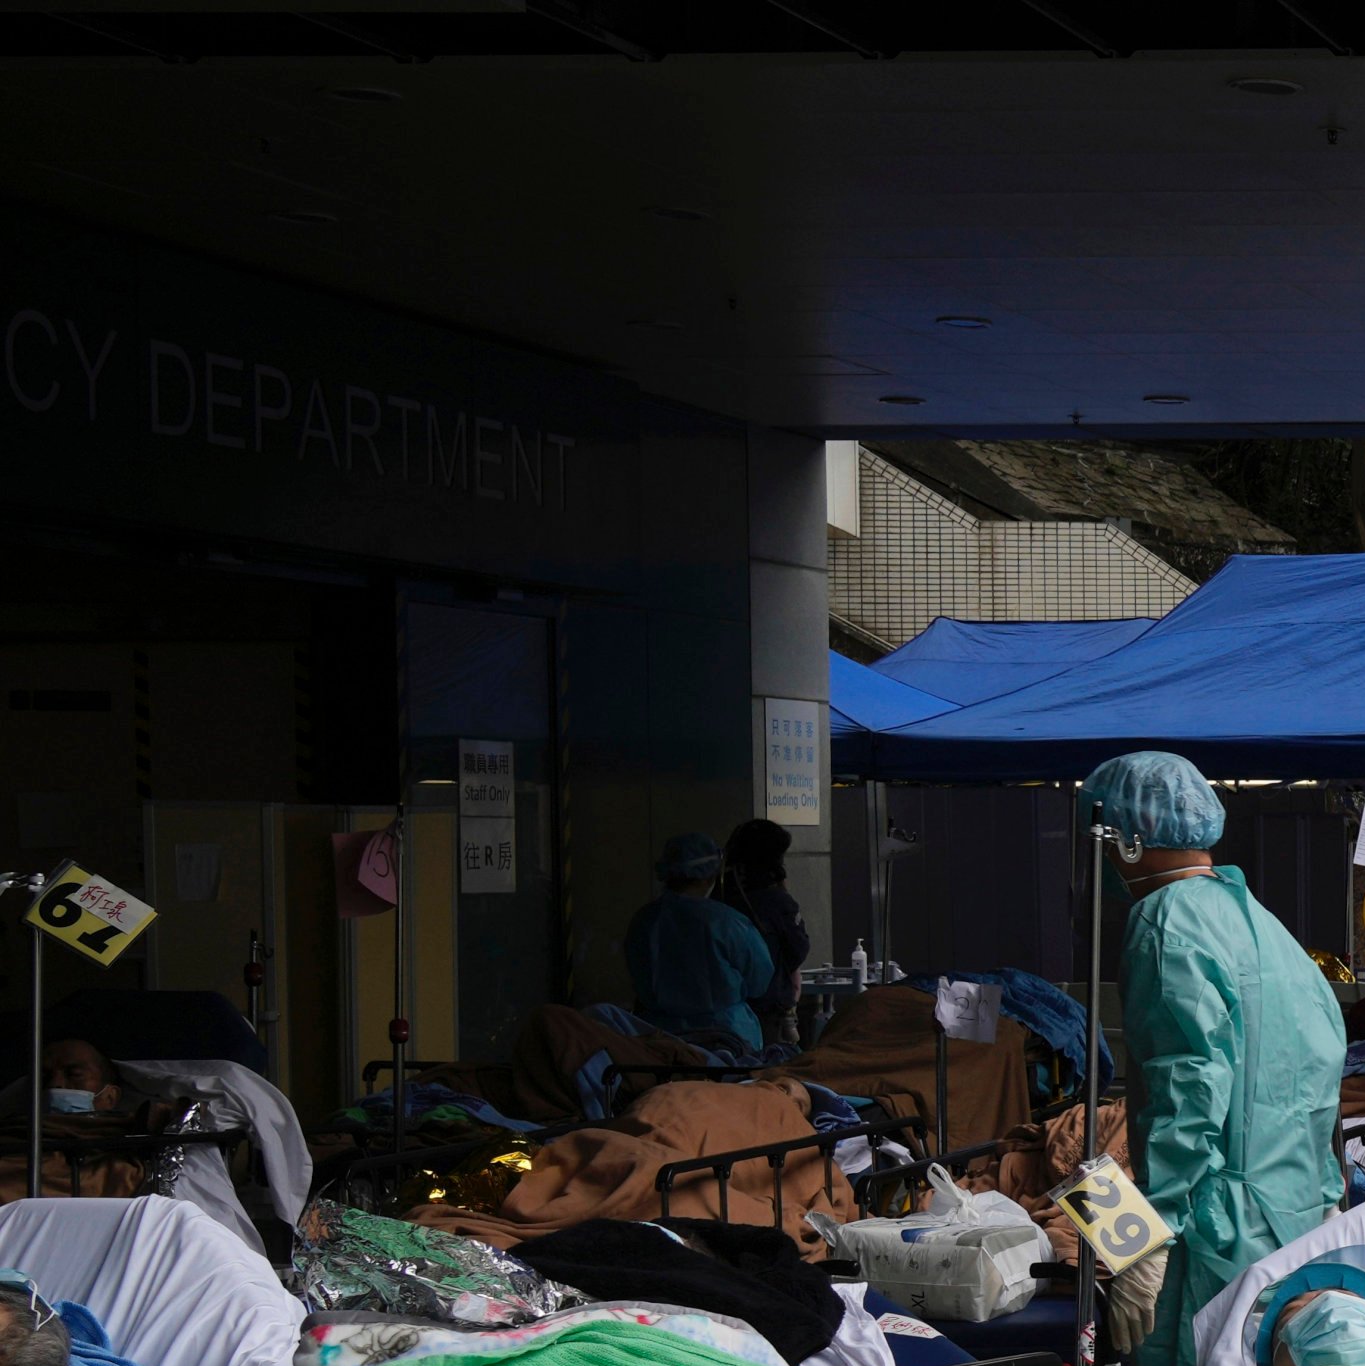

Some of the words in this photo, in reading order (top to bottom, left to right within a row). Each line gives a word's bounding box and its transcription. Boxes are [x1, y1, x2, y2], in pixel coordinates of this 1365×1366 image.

[5, 309, 117, 422] CY
[149, 338, 576, 513] DEPARTMENT
[463, 753, 509, 774] 職員專用
[772, 773, 783, 787] No
[786, 773, 814, 791] Waiting
[464, 785, 487, 801] Staff
[489, 786, 510, 806] Only
[768, 793, 798, 809] Loading
[801, 794, 817, 809] Only
[464, 842, 480, 870] 往
[485, 846, 493, 866] R
[498, 842, 512, 870] 房
[1064, 1175, 1151, 1257] 29
[911, 1291, 925, 1308] XL
